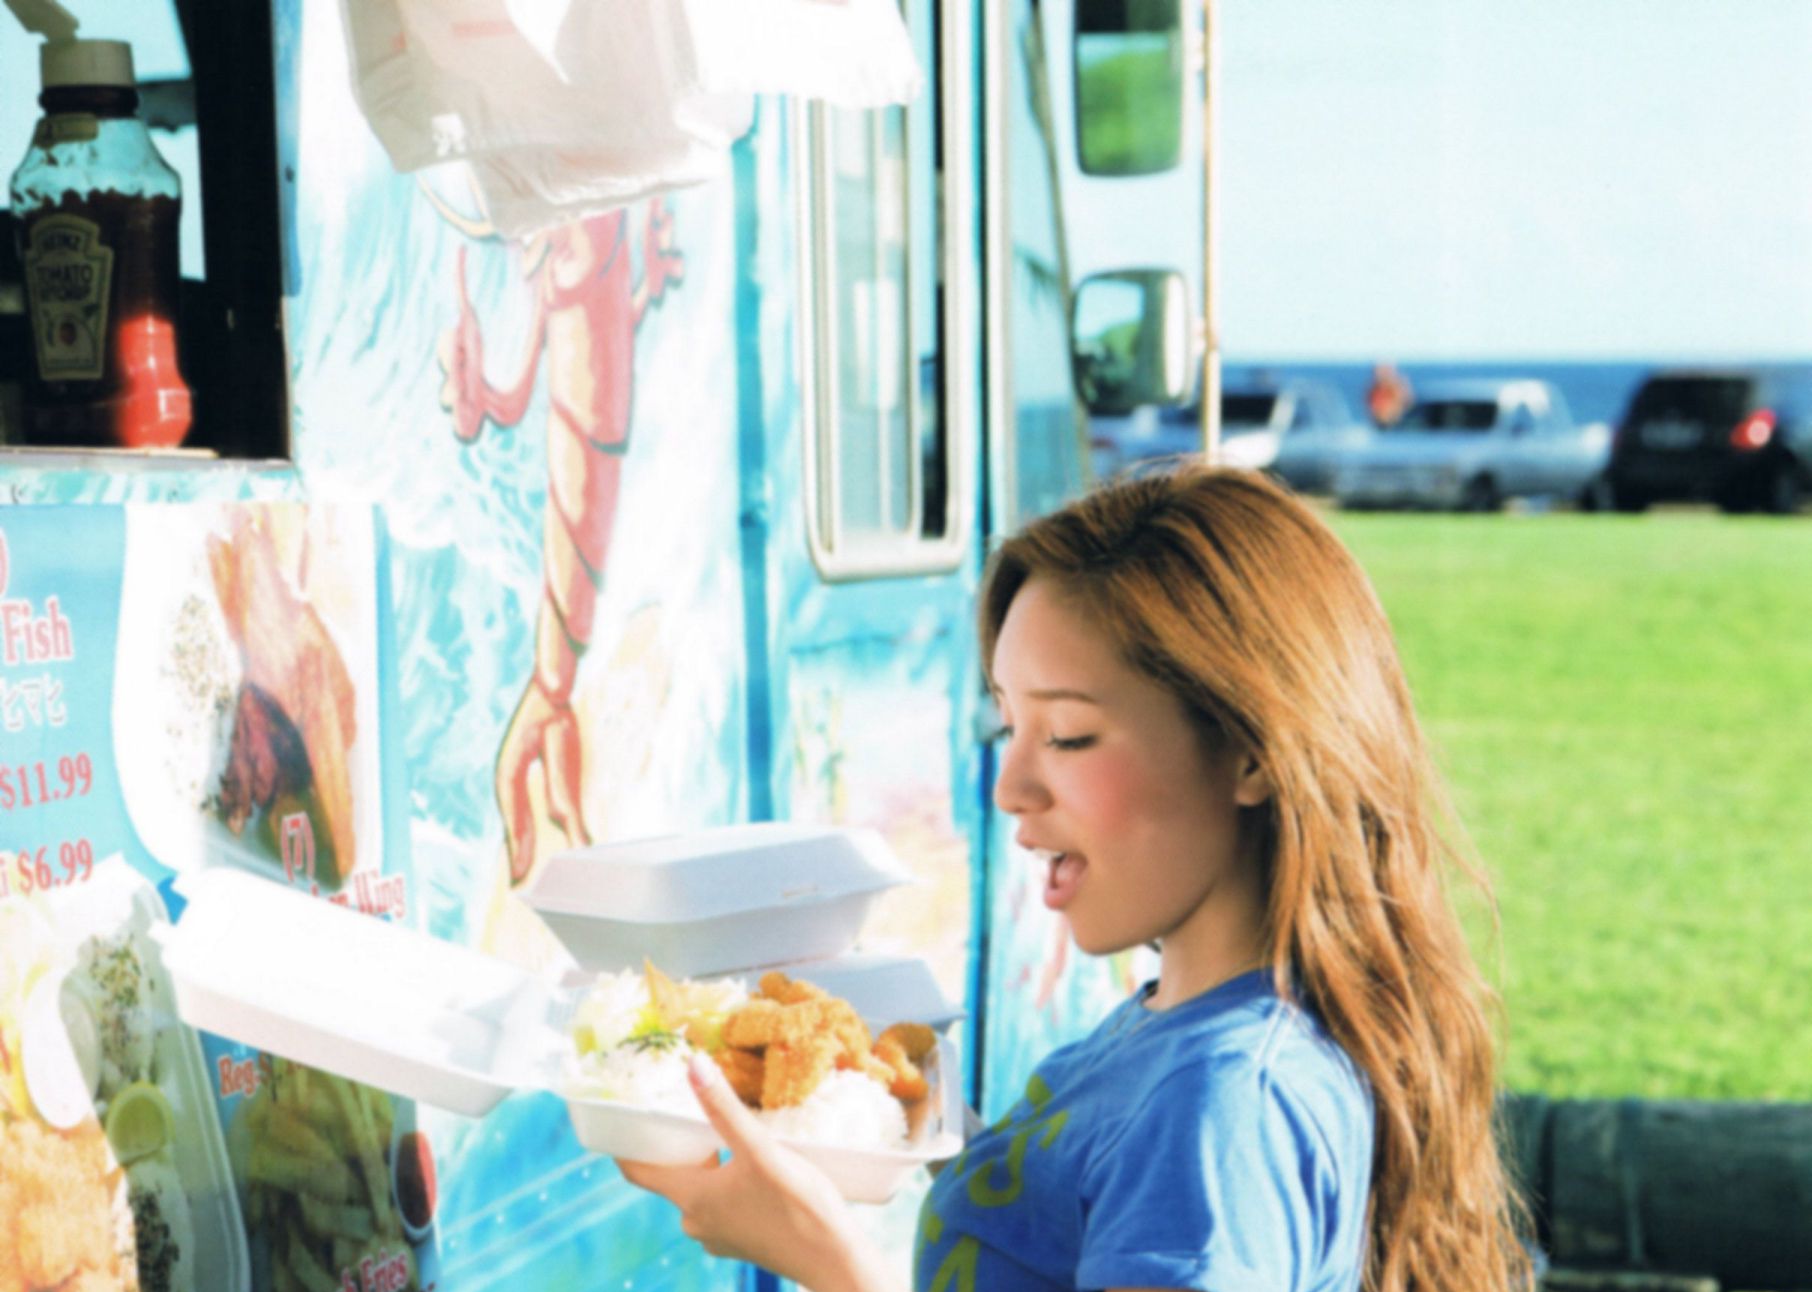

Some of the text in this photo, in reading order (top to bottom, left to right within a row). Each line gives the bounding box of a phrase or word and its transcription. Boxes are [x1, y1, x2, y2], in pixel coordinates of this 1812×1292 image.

[36, 264, 93, 285] TOMATO
[0, 598, 73, 662] Fish
[0, 751, 93, 811] $11.99
[16, 837, 93, 896] $6.99
